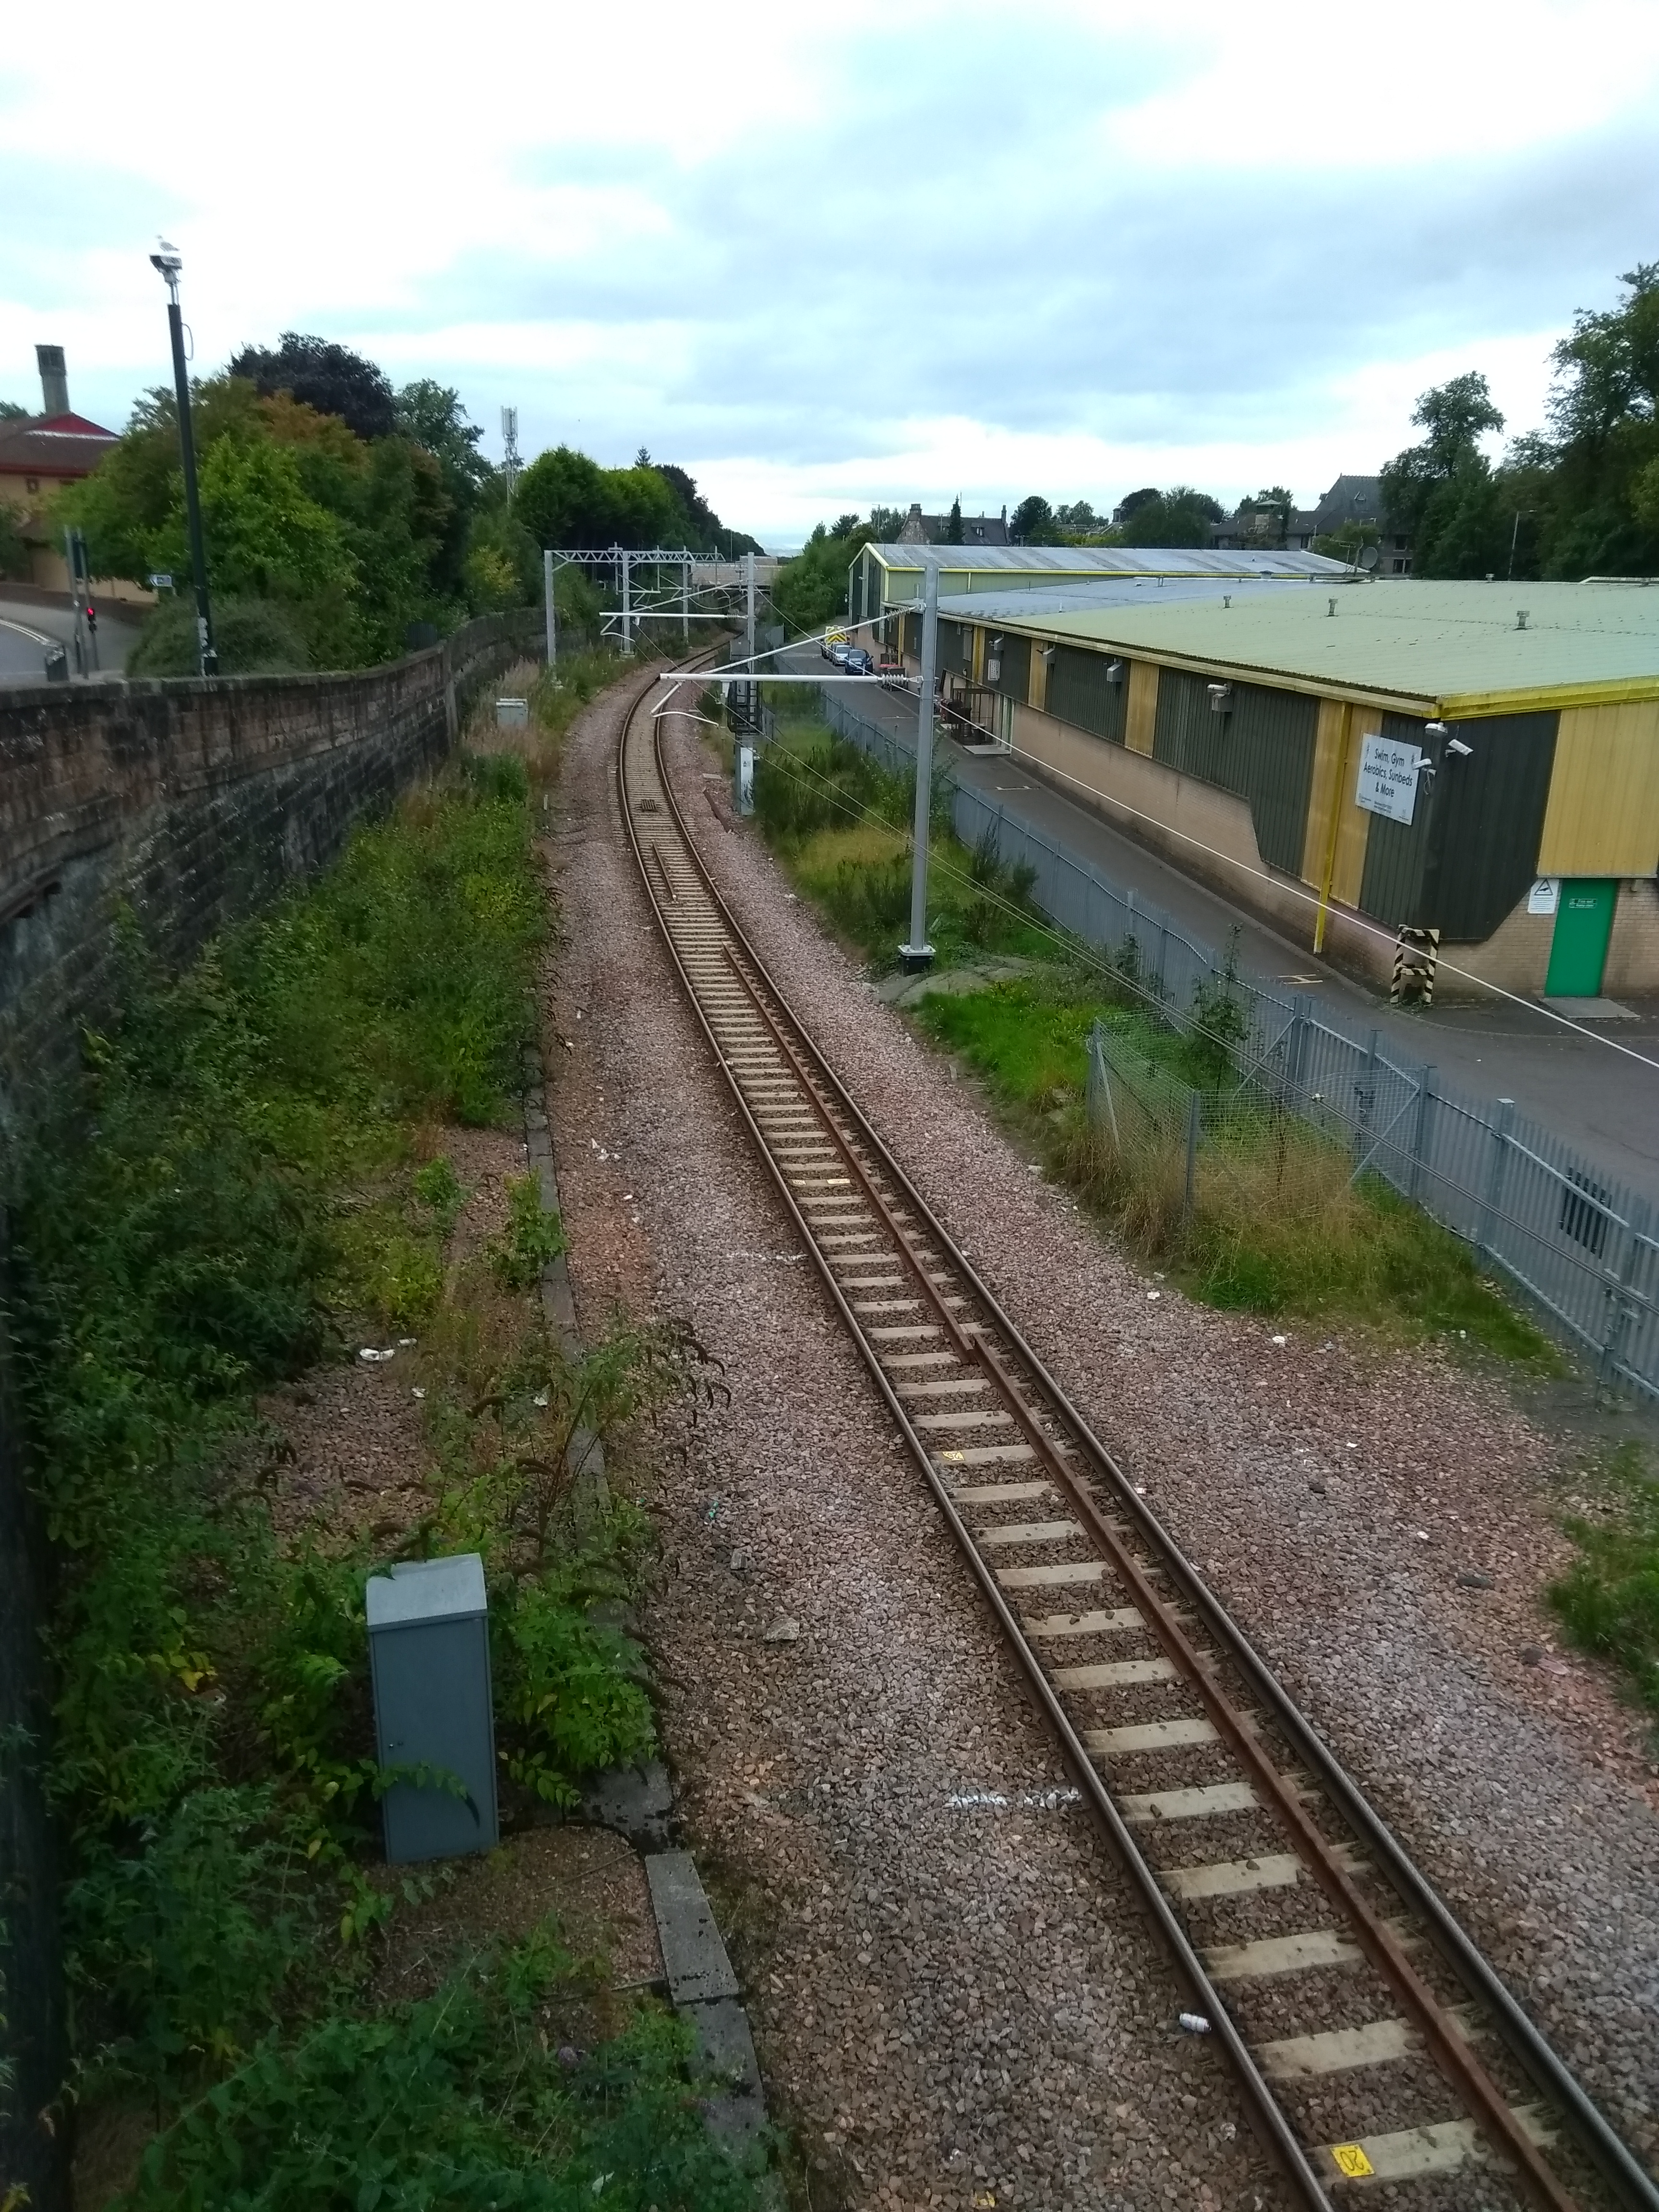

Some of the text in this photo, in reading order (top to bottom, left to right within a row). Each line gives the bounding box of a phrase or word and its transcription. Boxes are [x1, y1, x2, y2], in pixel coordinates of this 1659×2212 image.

[1374, 748, 1405, 768] Swim, Gym
[1363, 761, 1413, 787] Aerobics, Sunbeds
[1375, 782, 1395, 797] & More
[1340, 2151, 1364, 2171] 20
